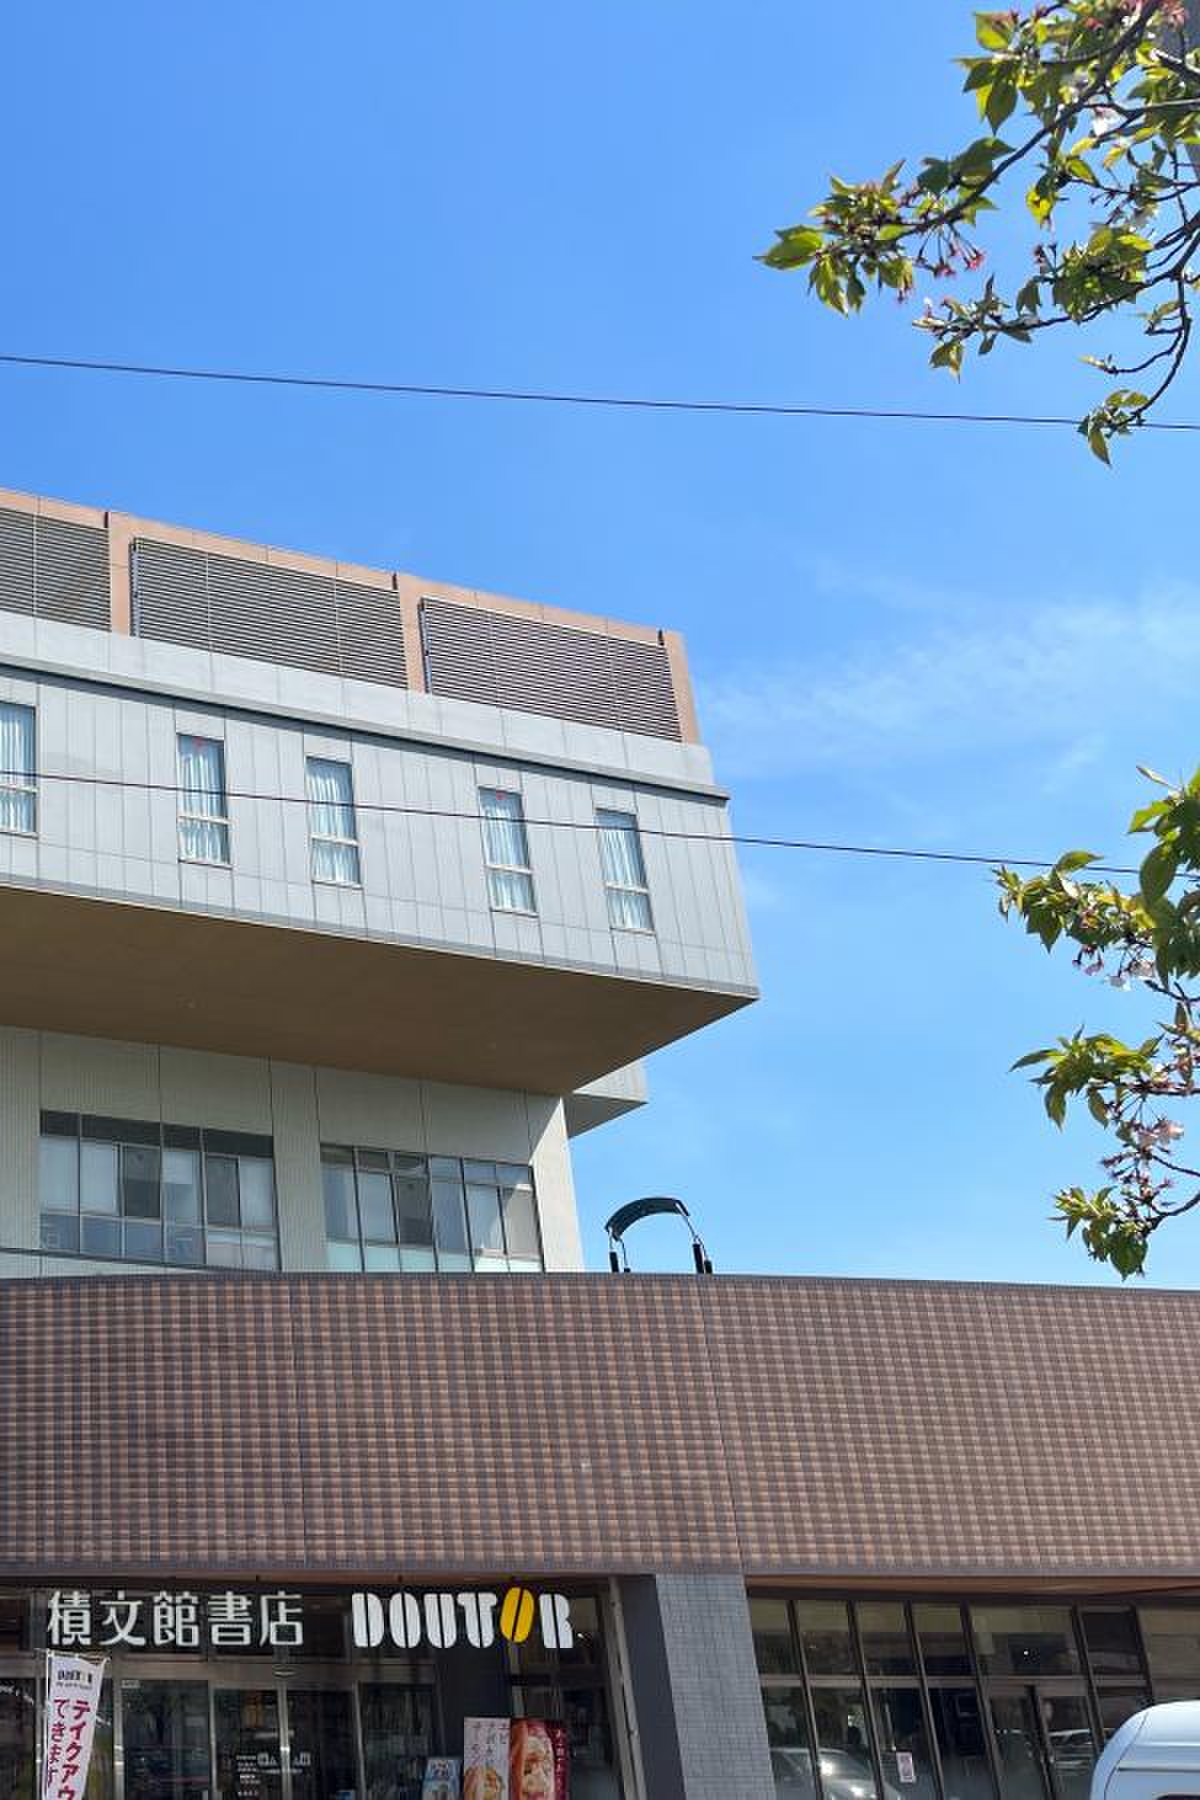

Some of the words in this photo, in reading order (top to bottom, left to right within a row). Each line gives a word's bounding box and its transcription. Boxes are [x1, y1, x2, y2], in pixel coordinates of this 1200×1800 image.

[47, 1590, 304, 1647] 積文館書店
[351, 1586, 575, 1649] DOUTOR
